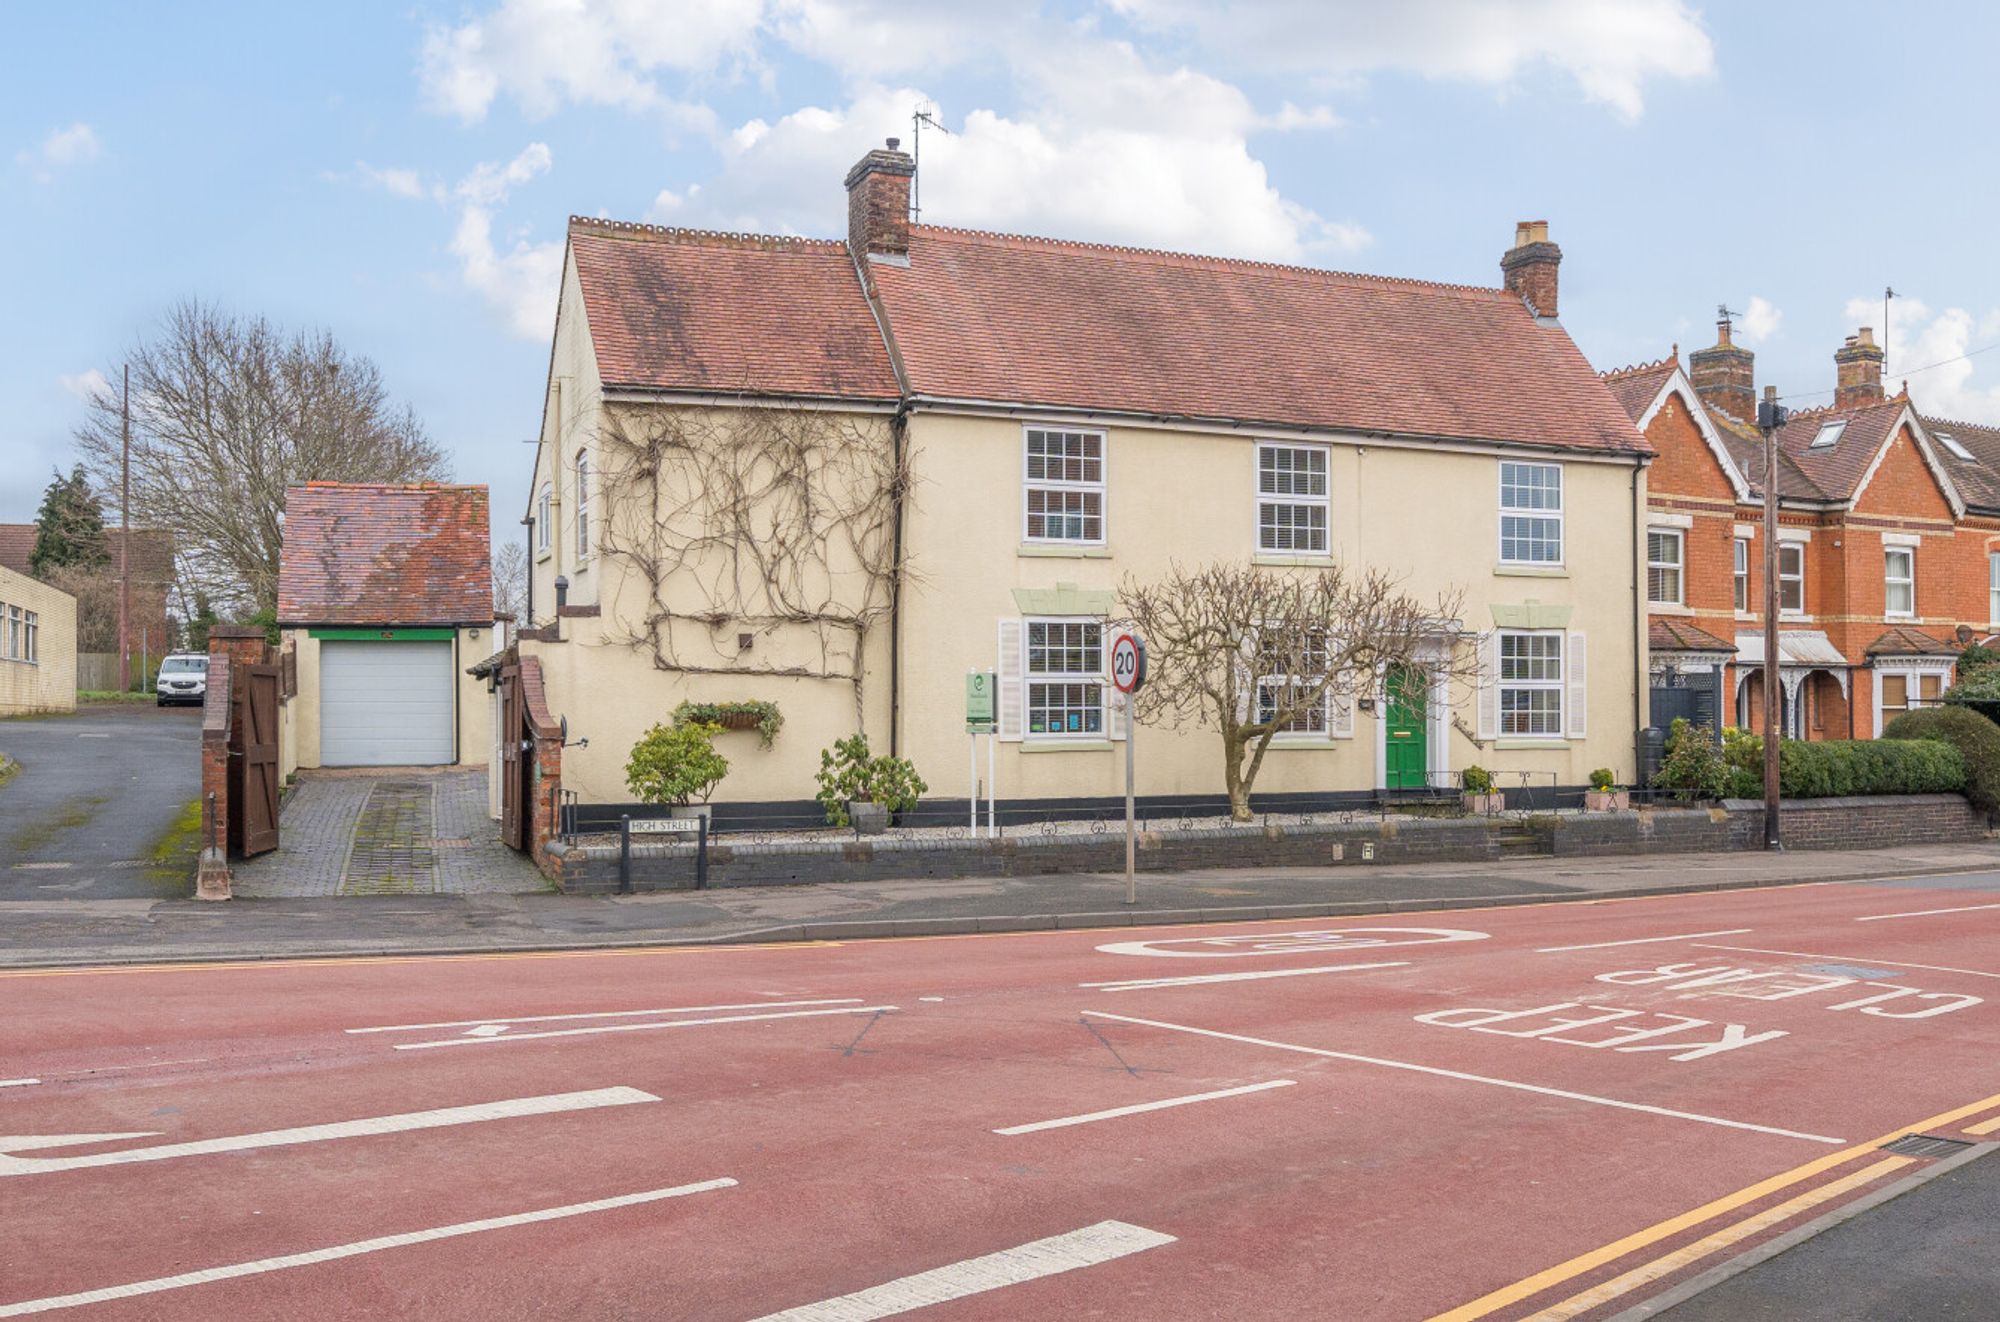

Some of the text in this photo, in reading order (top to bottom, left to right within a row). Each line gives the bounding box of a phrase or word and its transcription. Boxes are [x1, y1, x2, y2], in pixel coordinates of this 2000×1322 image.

[1115, 652, 1135, 675] 20
[632, 820, 695, 832] HIGH STREET
[1594, 963, 1985, 1018] CLEAR
[1413, 1003, 1790, 1061] KEEP
